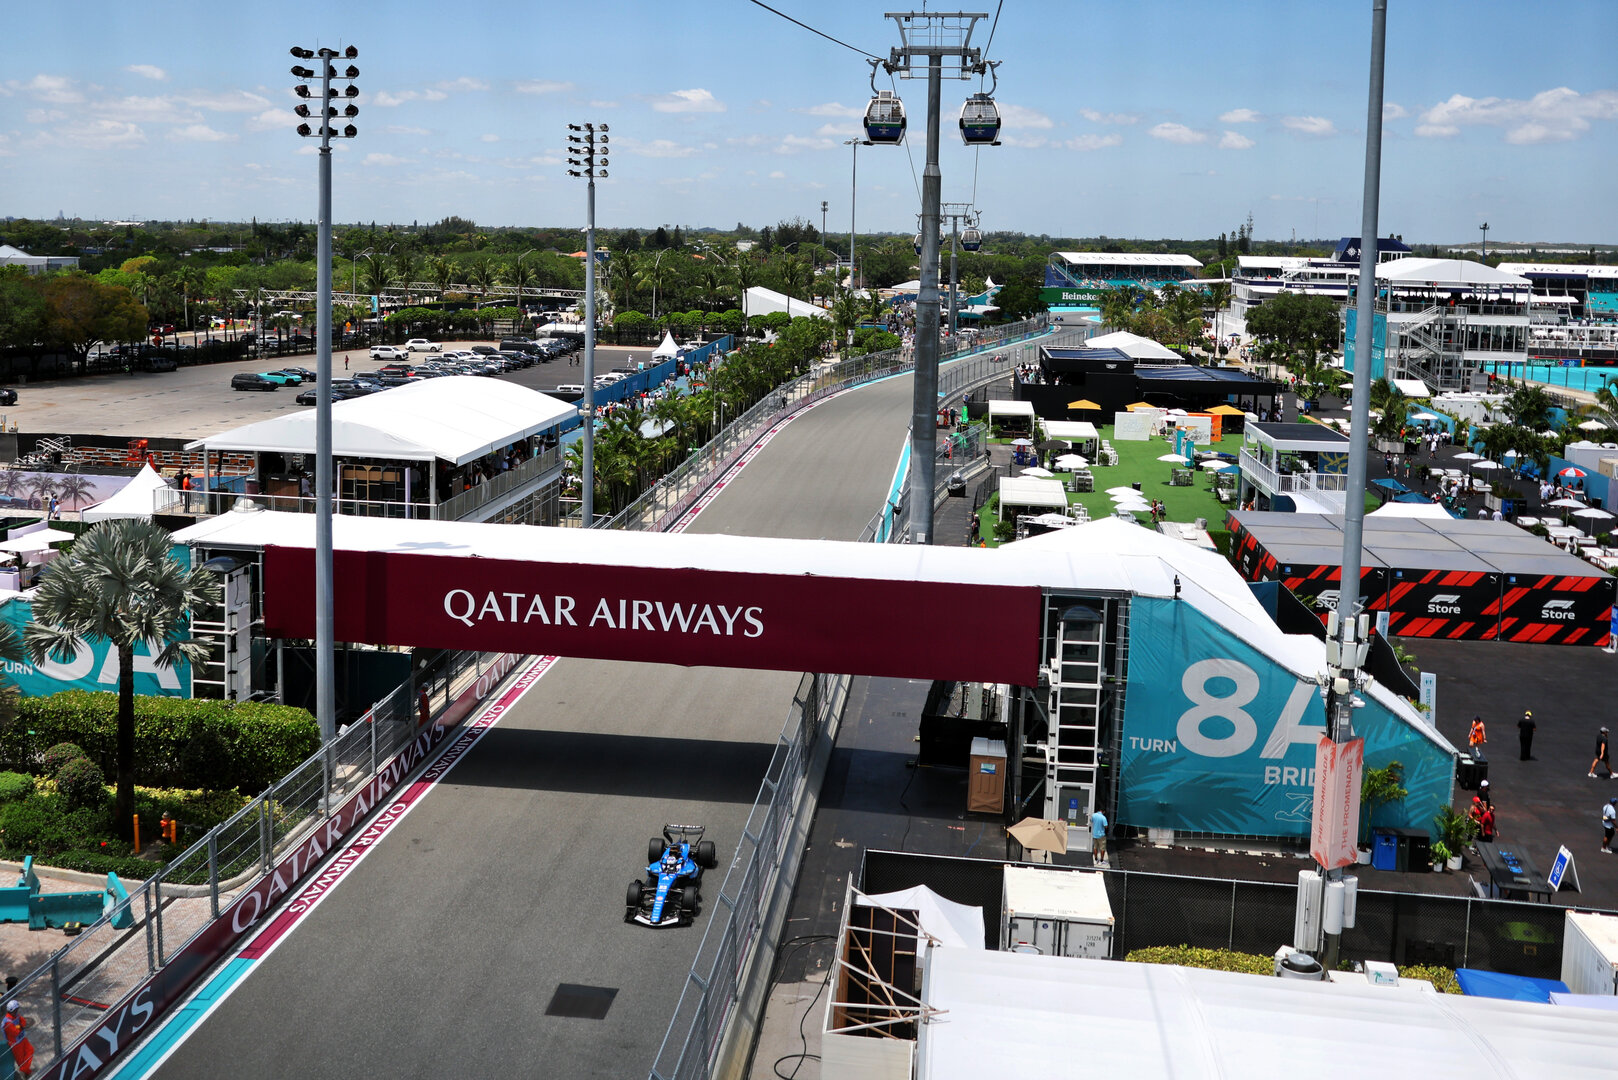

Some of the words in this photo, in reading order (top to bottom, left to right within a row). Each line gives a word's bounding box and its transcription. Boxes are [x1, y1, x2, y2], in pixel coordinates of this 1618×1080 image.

[1062, 292, 1099, 301] Heineke
[443, 589, 578, 628] QATAR
[589, 597, 765, 638] AIRWAYS
[1427, 604, 1461, 614] Store
[1541, 609, 1576, 620] Store
[470, 704, 505, 736] QATAR
[425, 736, 474, 779] AIRWAYS
[1129, 736, 1177, 754] TURN
[1265, 766, 1316, 786] BRI
[1319, 754, 1329, 822] PROMENADE
[1343, 759, 1354, 827] PROMENADE
[232, 814, 344, 934] QATAR
[351, 717, 445, 827] AIRWAYS
[355, 803, 407, 846] QATAR
[1341, 828, 1349, 849] THE
[289, 848, 360, 913] AIRWAYS
[58, 986, 155, 1080] AYS
